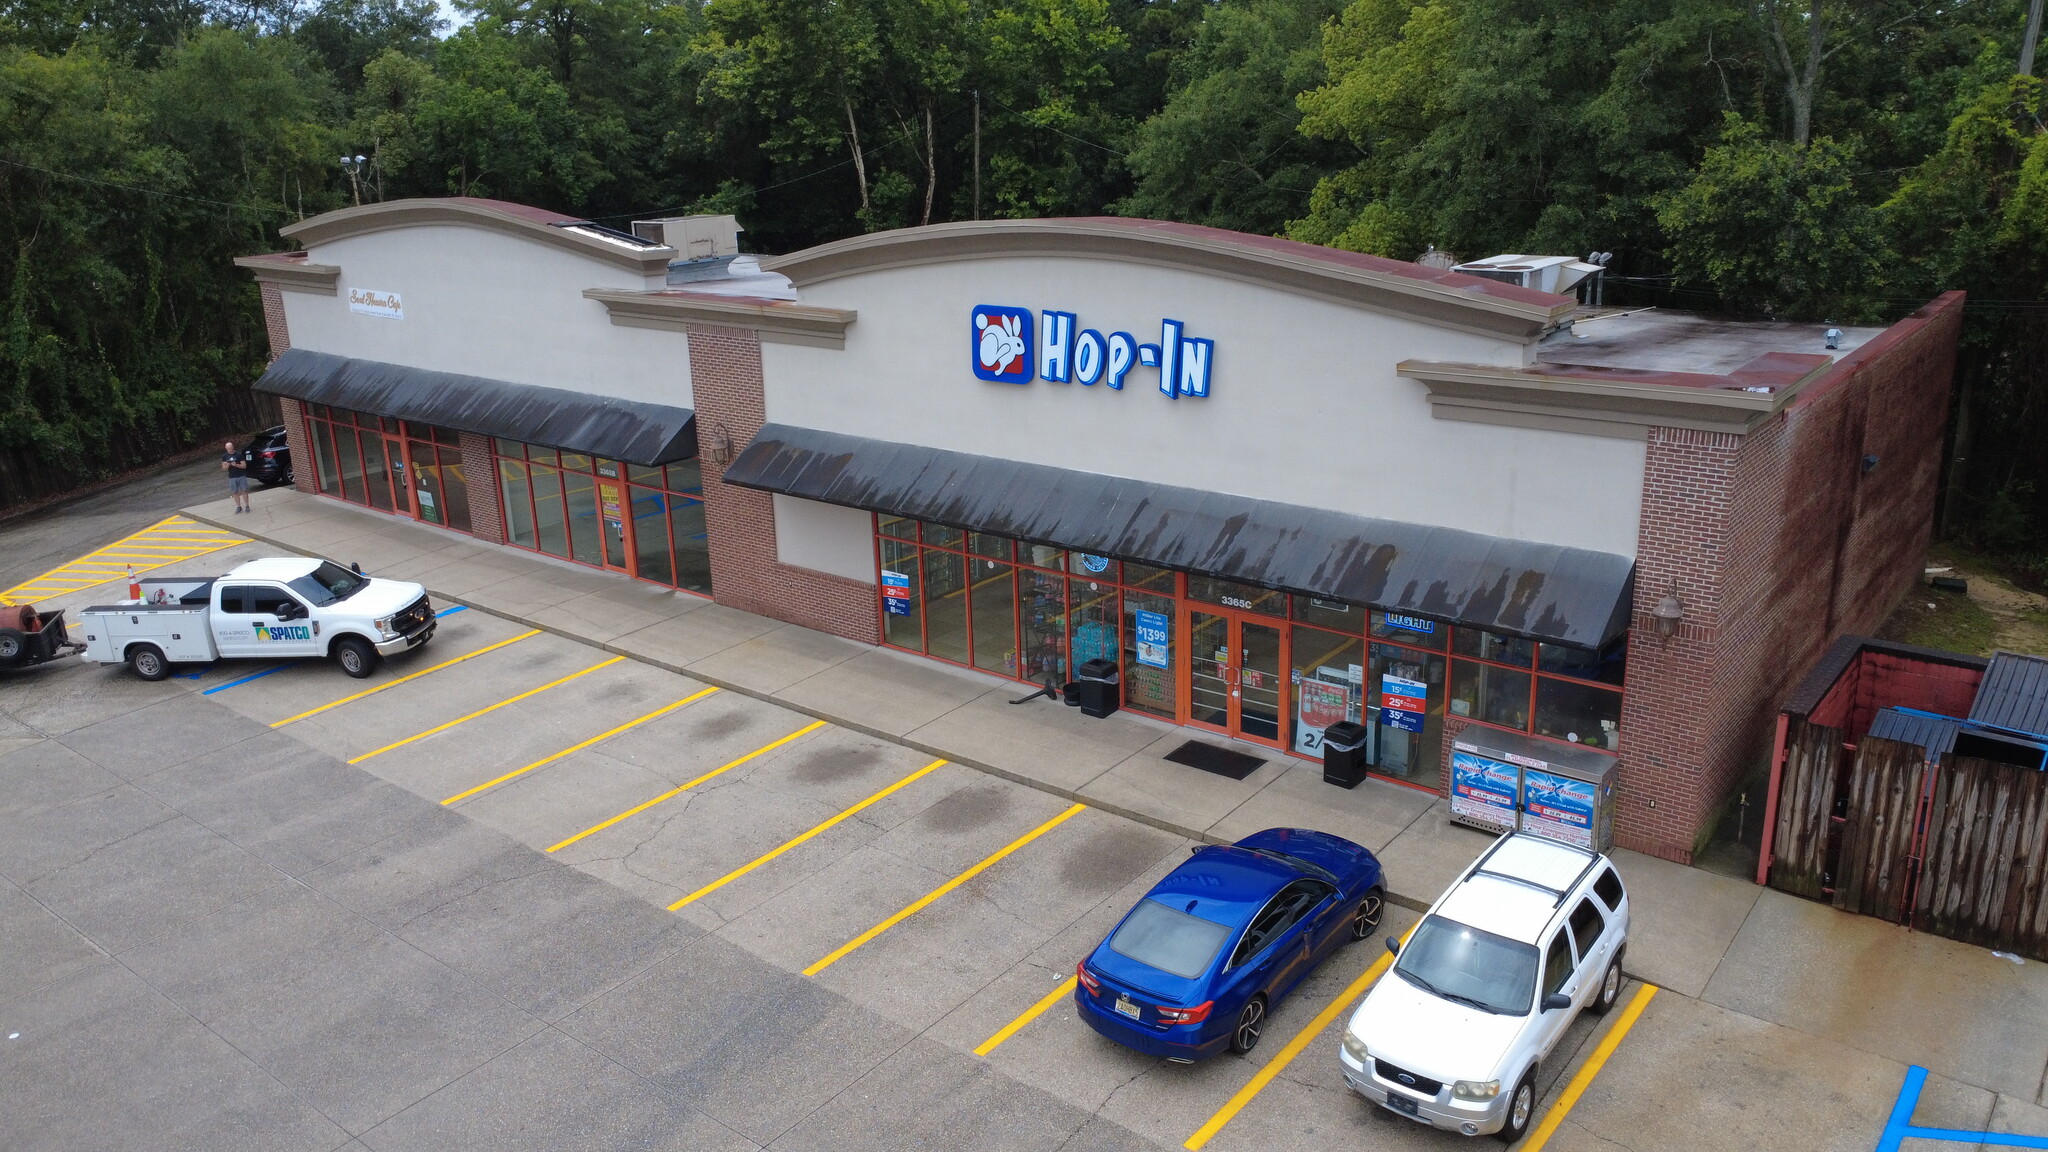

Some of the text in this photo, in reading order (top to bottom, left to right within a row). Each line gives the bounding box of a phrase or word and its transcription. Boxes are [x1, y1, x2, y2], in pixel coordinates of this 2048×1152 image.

[1040, 309, 1214, 400] HOP-IN
[1221, 595, 1252, 609] 3365C
[269, 626, 311, 641] SPATCO
[1391, 685, 1403, 694] 15¢
[1388, 697, 1404, 707] 25¢
[1388, 709, 1404, 720] 35¢
[1458, 763, 1483, 775] Rapid
[1530, 781, 1556, 792] Rapid
